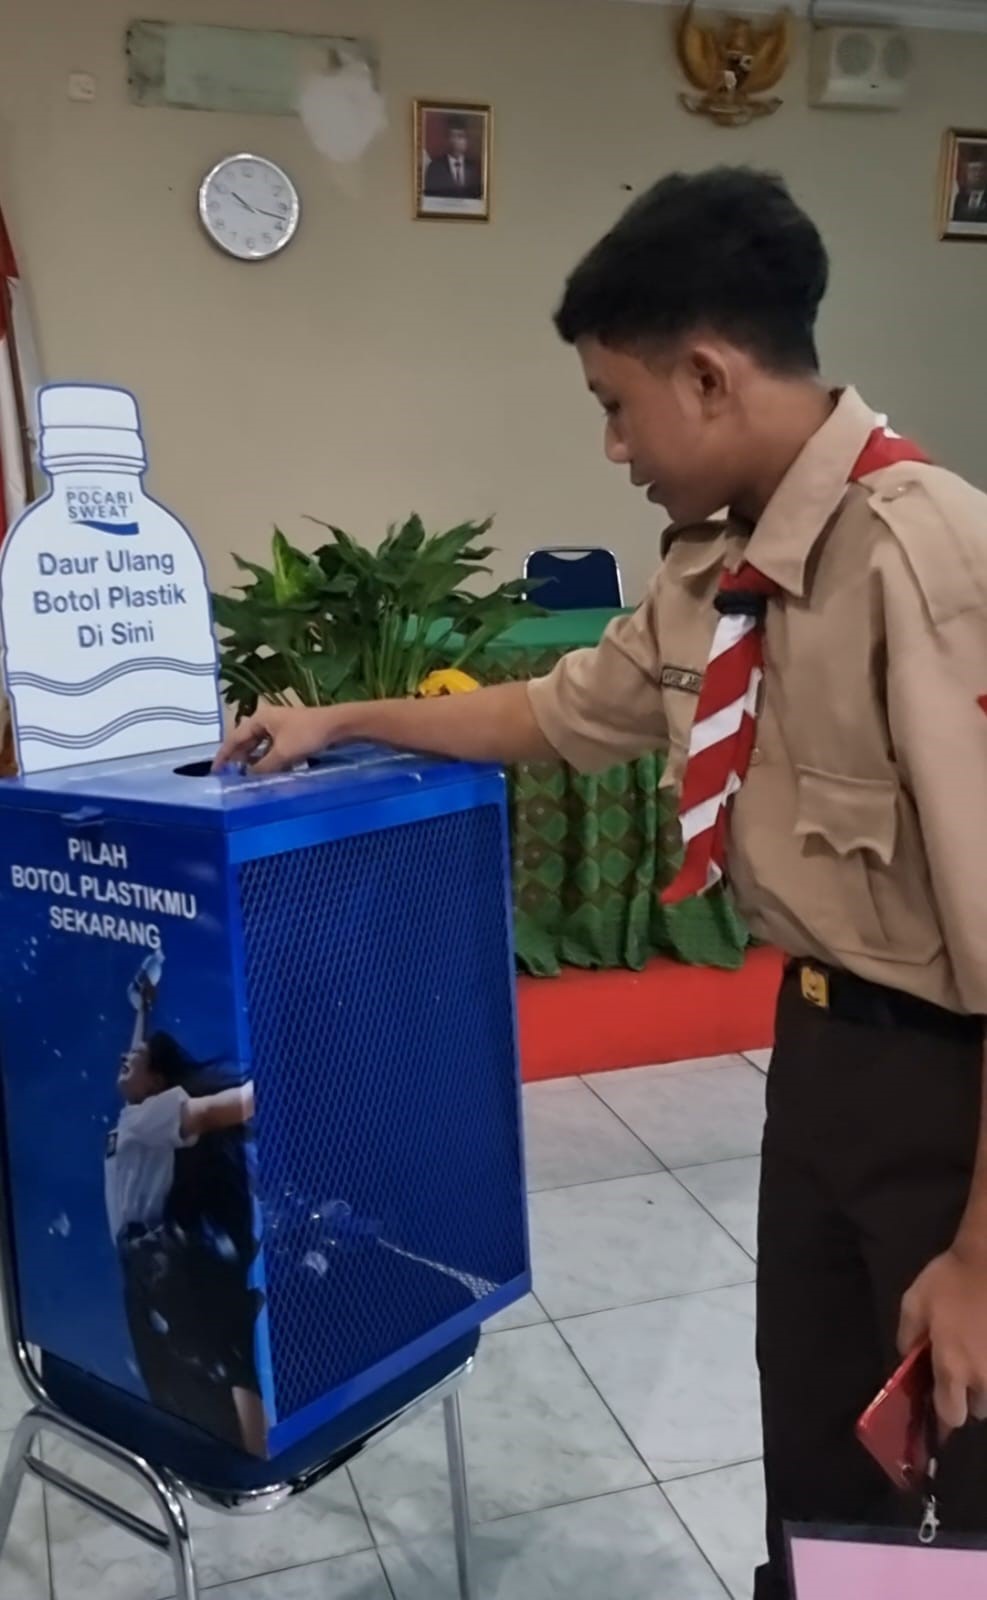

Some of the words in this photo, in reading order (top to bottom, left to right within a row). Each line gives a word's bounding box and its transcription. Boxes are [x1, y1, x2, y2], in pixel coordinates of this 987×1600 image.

[66, 490, 134, 505] POCARI
[68, 505, 129, 519] SWEAT
[37, 551, 98, 576] Daur
[106, 549, 175, 576] Ulang
[33, 587, 100, 614] Botol
[108, 583, 187, 610] Plastik
[77, 624, 104, 649] Di
[111, 620, 155, 646] Sini
[67, 838, 129, 869] PILAH
[11, 864, 77, 897] BOTOL
[80, 875, 198, 920] PLASTIKMU
[49, 905, 161, 950] SEKARANG
